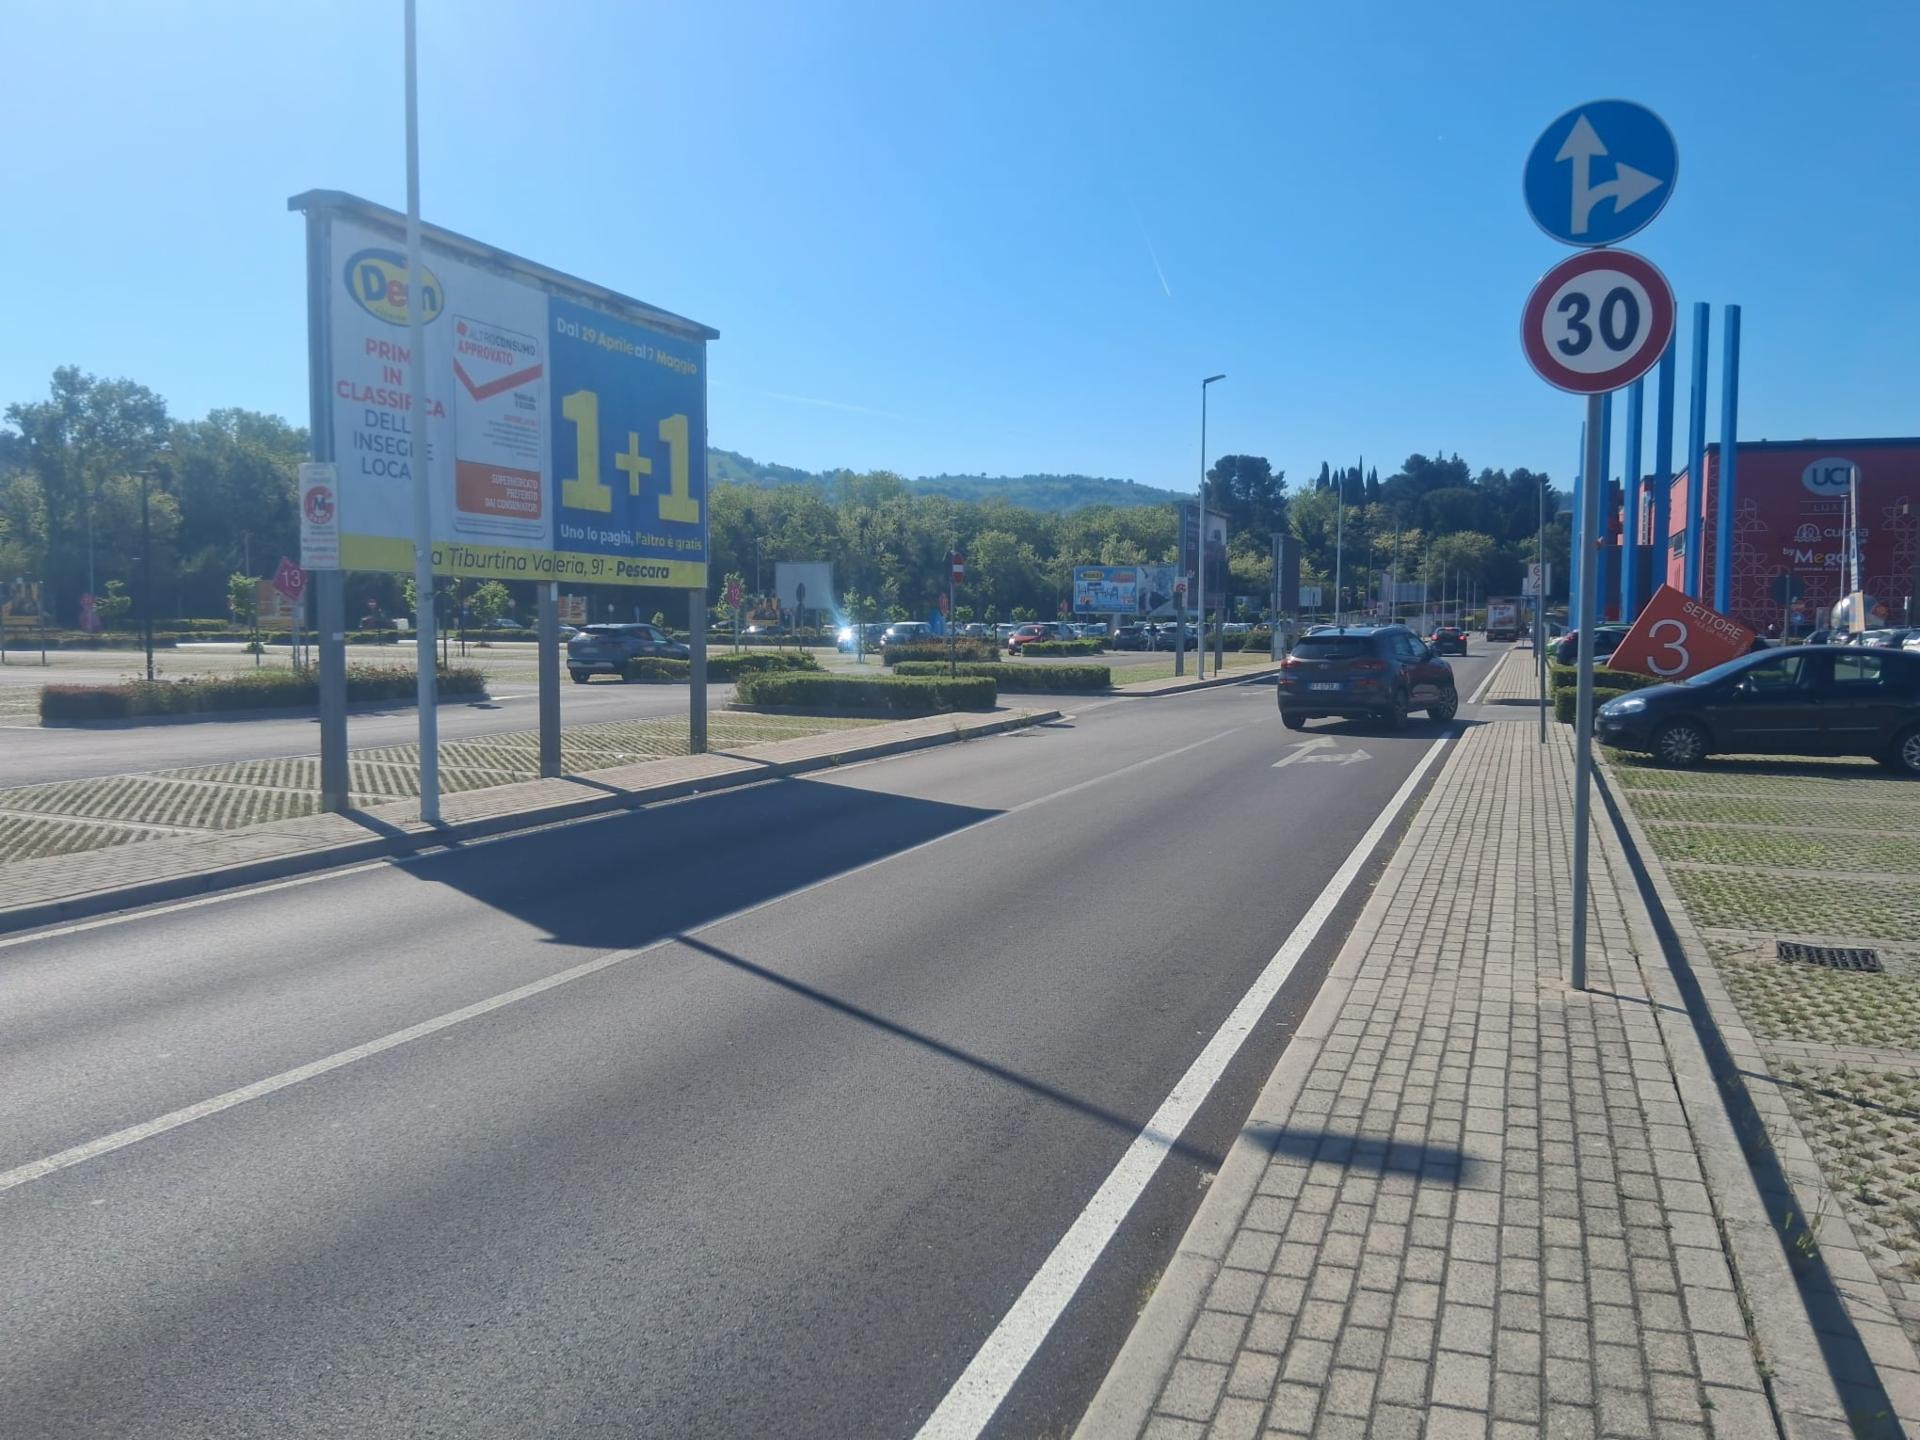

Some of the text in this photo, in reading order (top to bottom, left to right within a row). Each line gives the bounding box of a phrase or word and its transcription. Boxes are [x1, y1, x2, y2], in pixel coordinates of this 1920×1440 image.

[1557, 287, 1640, 356] 30
[366, 337, 413, 364] PRIM
[458, 340, 513, 366] APPROVATO
[556, 317, 697, 375] Dal 29 Aprile al 7 Maggio
[384, 366, 402, 386] IN
[337, 379, 446, 418] CLASSIFCA
[365, 409, 412, 435] DELL
[354, 431, 434, 461] INSEGE
[362, 456, 412, 480] LOCA
[1812, 467, 1852, 487] UCI
[560, 524, 584, 539] Uno
[587, 526, 598, 541] lo
[600, 529, 635, 547] paghi,
[675, 537, 702, 551] gratis
[449, 547, 527, 571] Tiburtina
[533, 553, 588, 577] Valeria,
[591, 558, 604, 575] 91
[616, 560, 670, 579] Pescara
[1783, 547, 1795, 557] by
[282, 569, 301, 588] 13
[1682, 602, 1744, 640] SETTORE
[1646, 618, 1689, 676] 3
